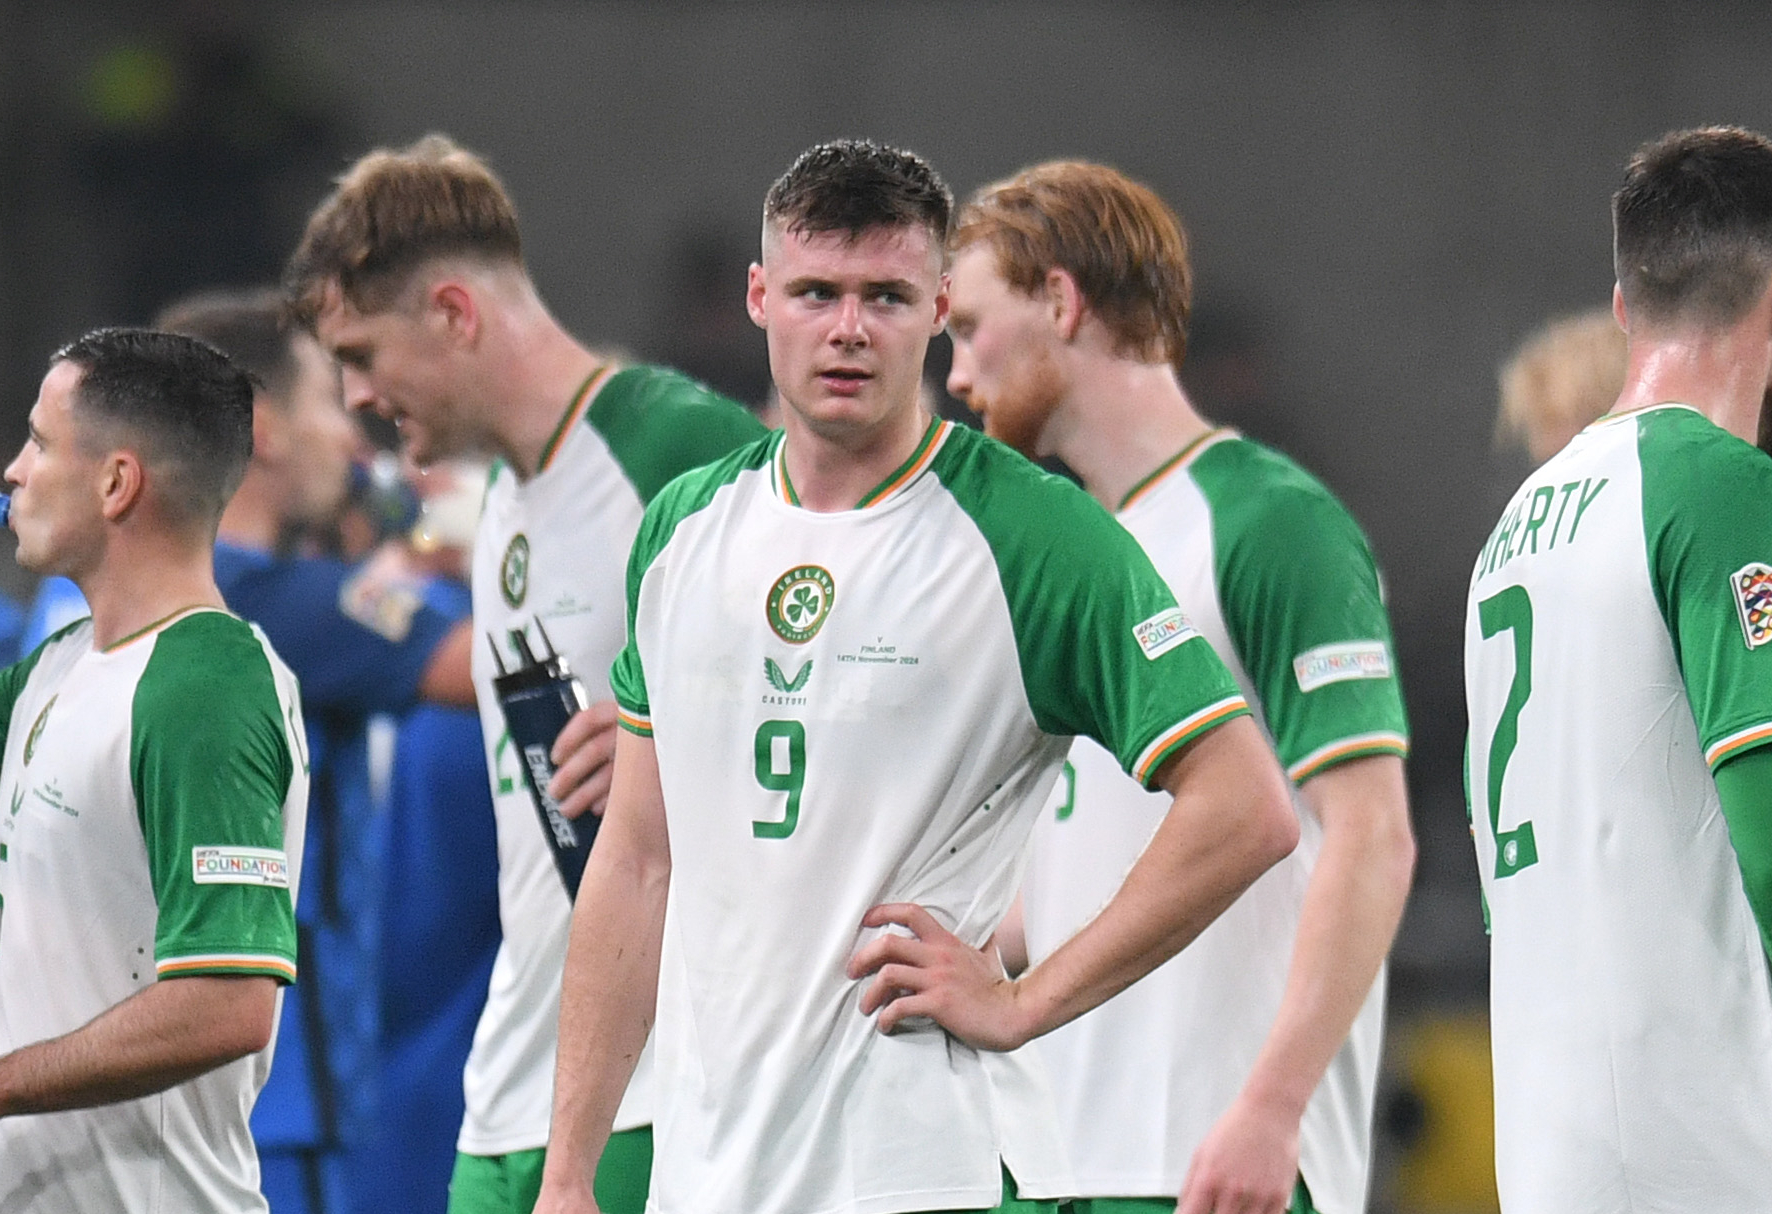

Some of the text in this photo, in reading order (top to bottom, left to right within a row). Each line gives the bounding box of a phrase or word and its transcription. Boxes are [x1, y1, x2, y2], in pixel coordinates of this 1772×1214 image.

[777, 569, 832, 595] IRELAND
[899, 656, 920, 665] 2024
[1478, 584, 1540, 880] 2
[752, 719, 806, 839] 9
[197, 858, 287, 875] FOUNDATION
